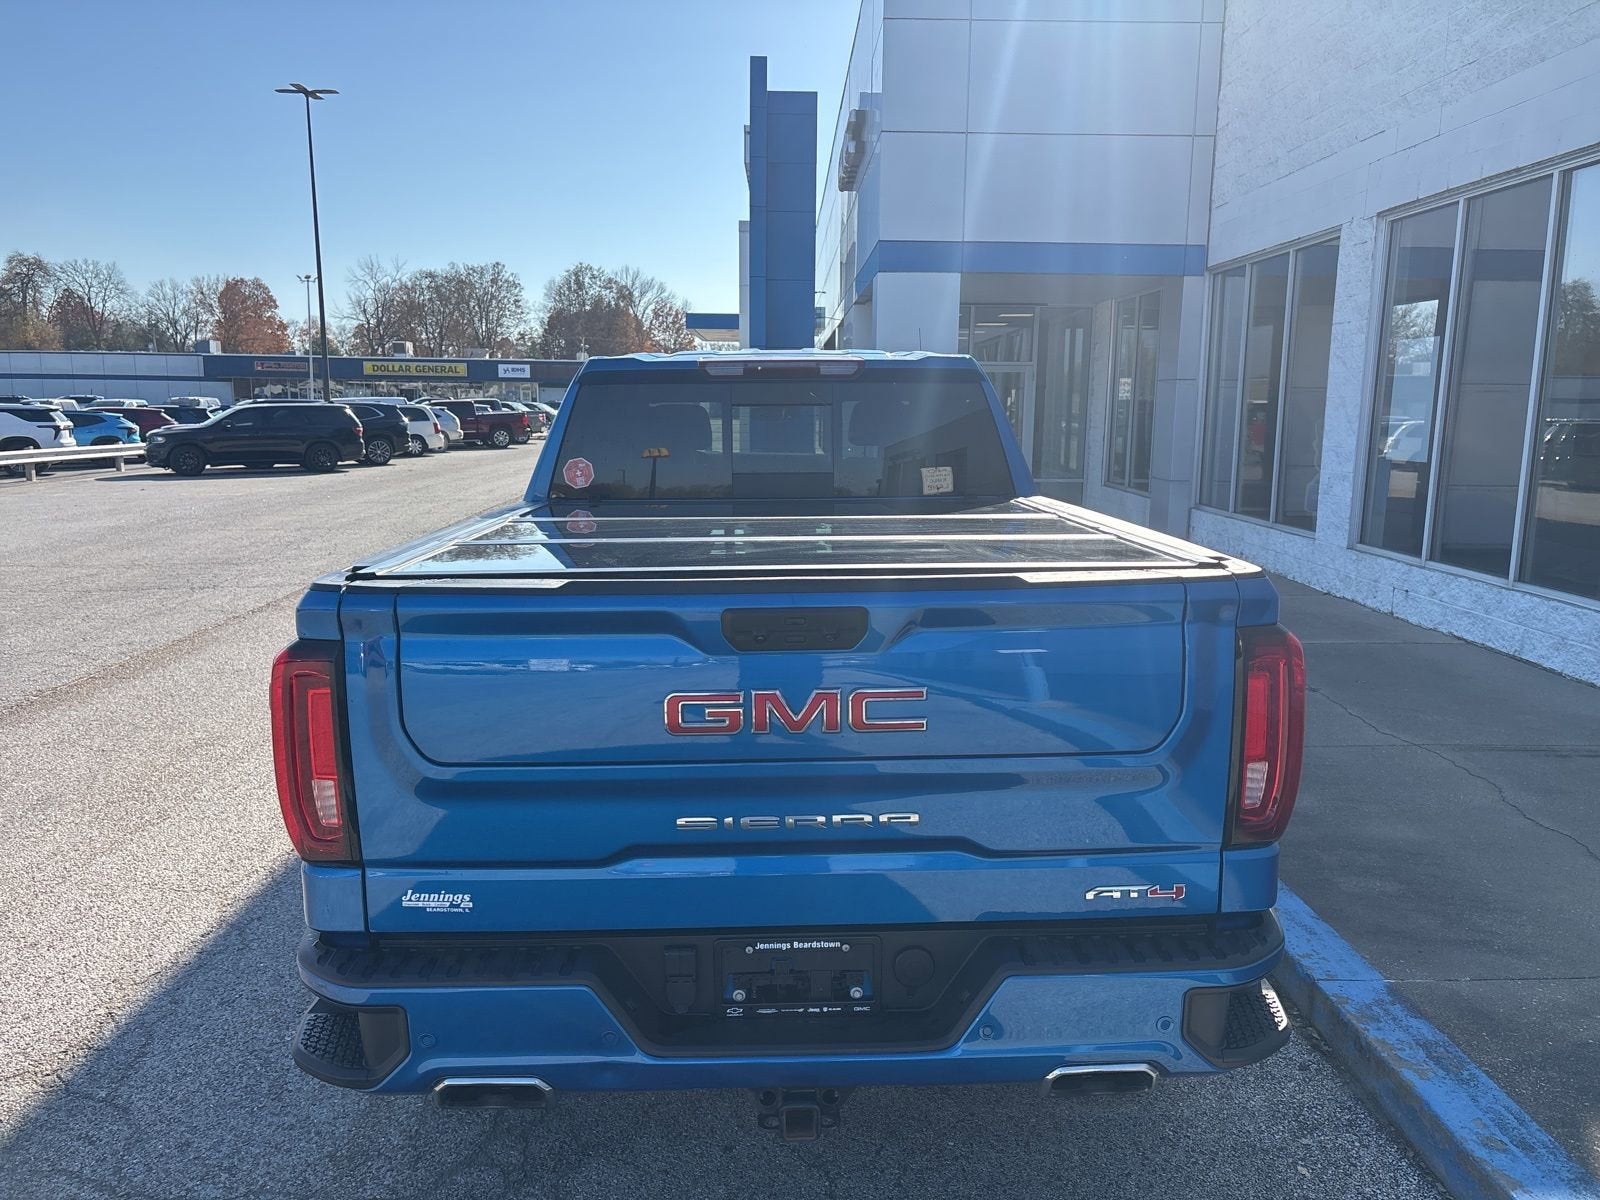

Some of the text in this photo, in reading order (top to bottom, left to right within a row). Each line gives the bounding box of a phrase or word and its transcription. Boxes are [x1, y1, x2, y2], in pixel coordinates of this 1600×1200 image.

[372, 364, 460, 374] DOLLAR GENERAL
[664, 687, 927, 736] GMC
[676, 812, 920, 830] SIERRA
[402, 889, 471, 905] Jennings
[1085, 884, 1186, 900] AT4
[755, 940, 841, 951] Jennings Beardstown
